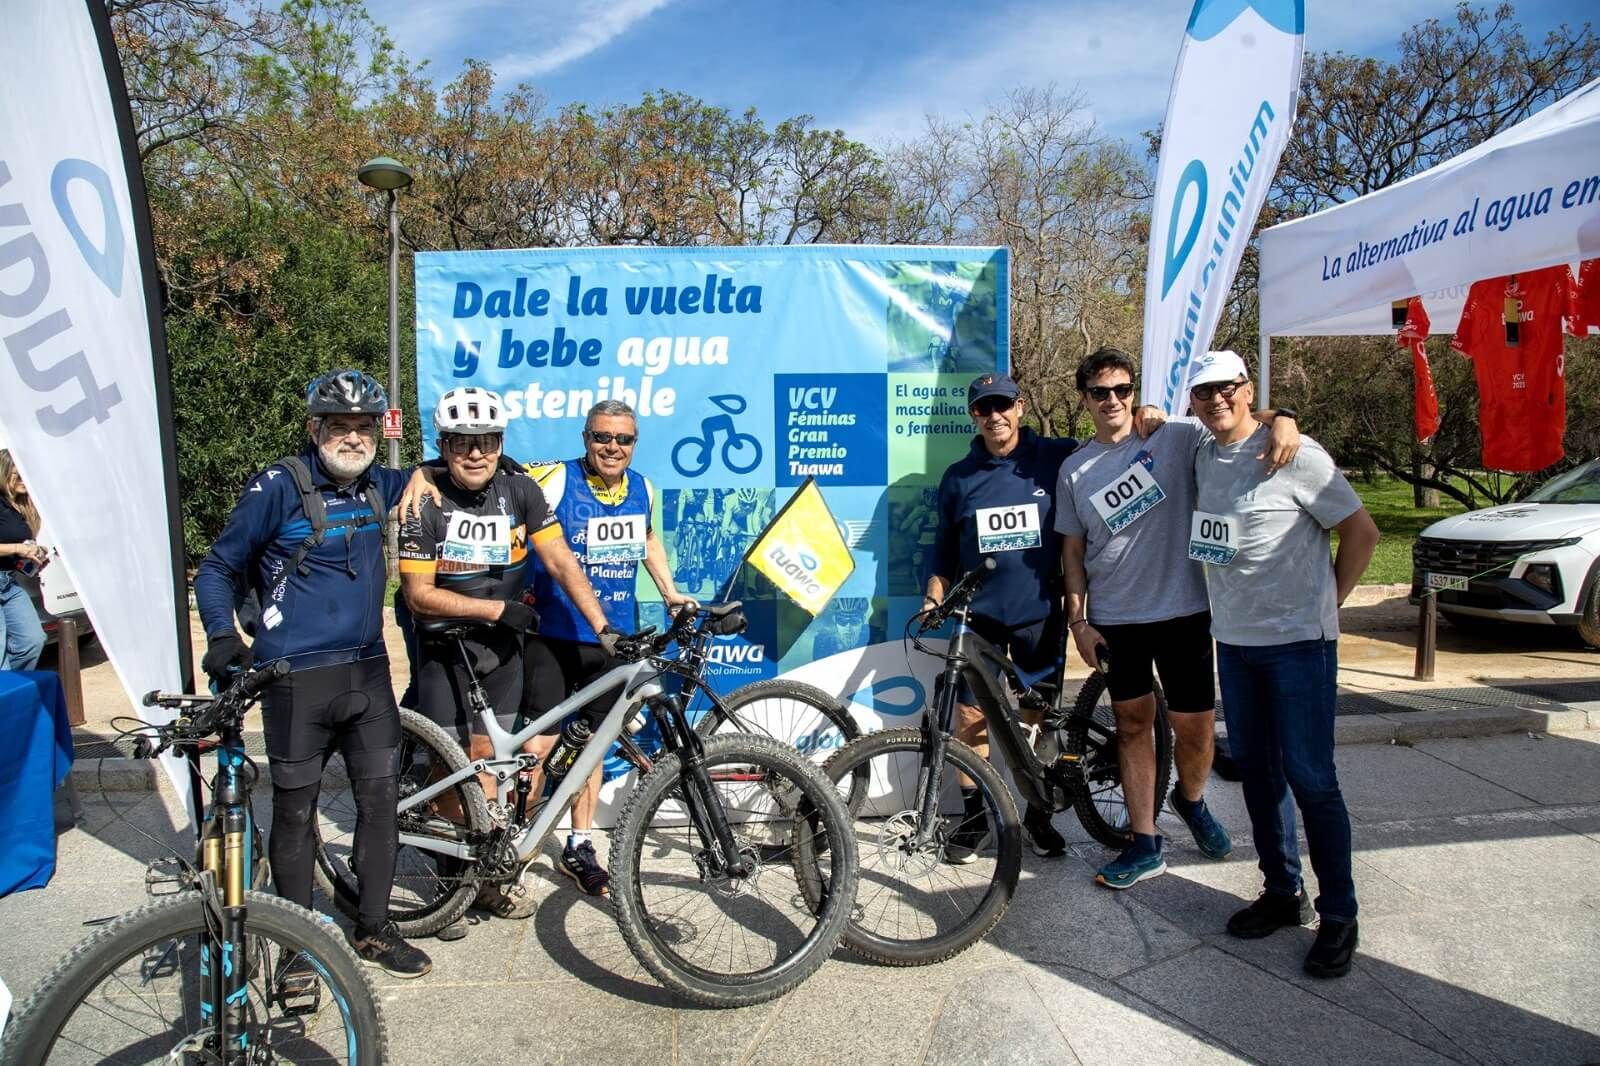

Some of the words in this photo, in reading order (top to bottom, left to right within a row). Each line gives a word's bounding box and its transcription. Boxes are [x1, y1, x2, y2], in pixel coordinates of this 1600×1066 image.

[1322, 256, 1341, 281] La
[1346, 217, 1448, 273] alternativa
[1453, 198, 1480, 237] al
[1484, 186, 1553, 232] agua
[453, 277, 552, 319] Dale
[566, 276, 609, 318] la
[624, 273, 763, 316] vuelta
[453, 340, 482, 379] y
[498, 327, 602, 369] bebe
[616, 335, 730, 377] agua
[502, 375, 677, 420] stenible
[788, 387, 837, 410] VCV
[895, 384, 908, 398] El
[912, 386, 948, 400] agua
[951, 387, 966, 398] es
[788, 411, 857, 426] Féminas
[895, 402, 967, 416] masculina
[788, 428, 829, 443] Gran
[895, 424, 904, 434] o
[788, 442, 848, 460] Premio
[789, 461, 844, 477] Tuawa
[1104, 473, 1144, 509] 001
[457, 519, 498, 542] 001
[988, 510, 1027, 531] 001
[597, 521, 635, 541] 001
[1200, 519, 1229, 543] 001
[768, 545, 821, 597] tuawa
[706, 644, 765, 663] awa
[723, 667, 762, 676] omnium
